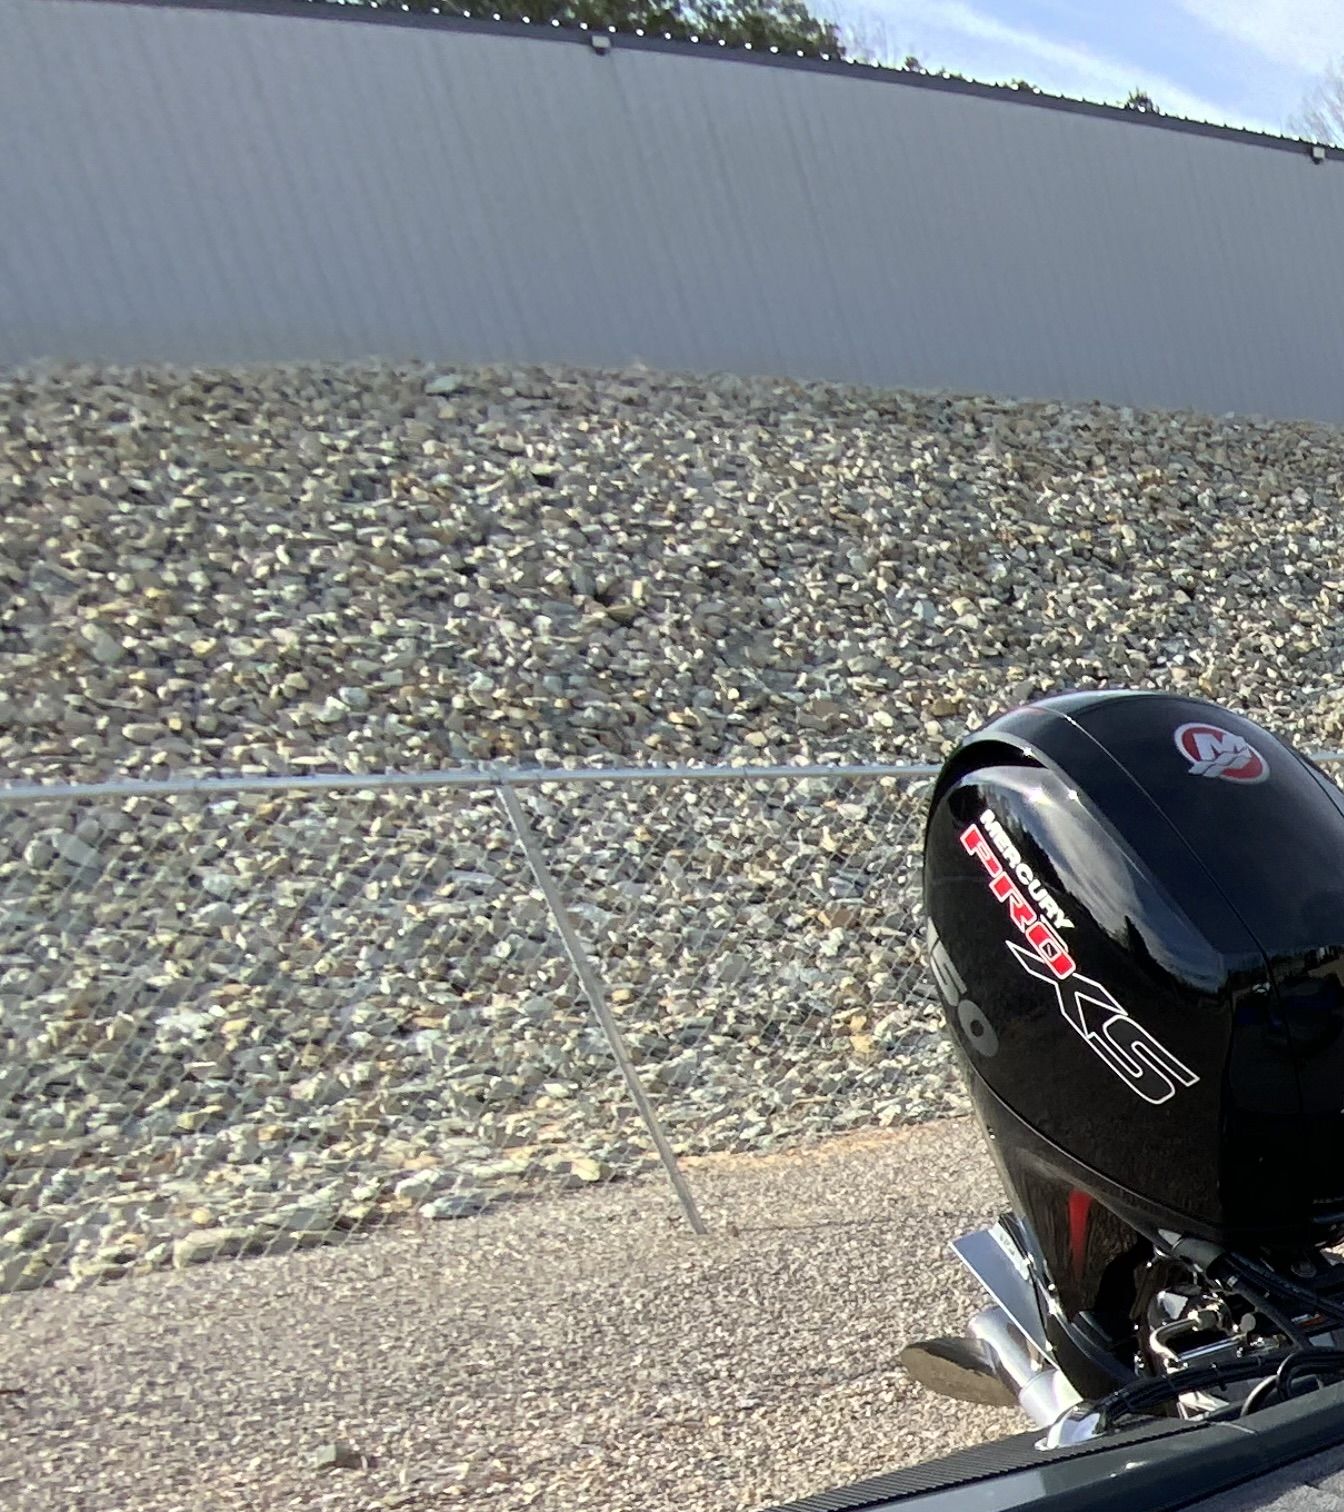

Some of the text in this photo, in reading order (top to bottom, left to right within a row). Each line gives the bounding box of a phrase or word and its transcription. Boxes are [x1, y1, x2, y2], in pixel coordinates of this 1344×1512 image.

[960, 823, 1077, 980] PRO
[979, 808, 1075, 930] MERCURY
[1005, 939, 1201, 1105] XS
